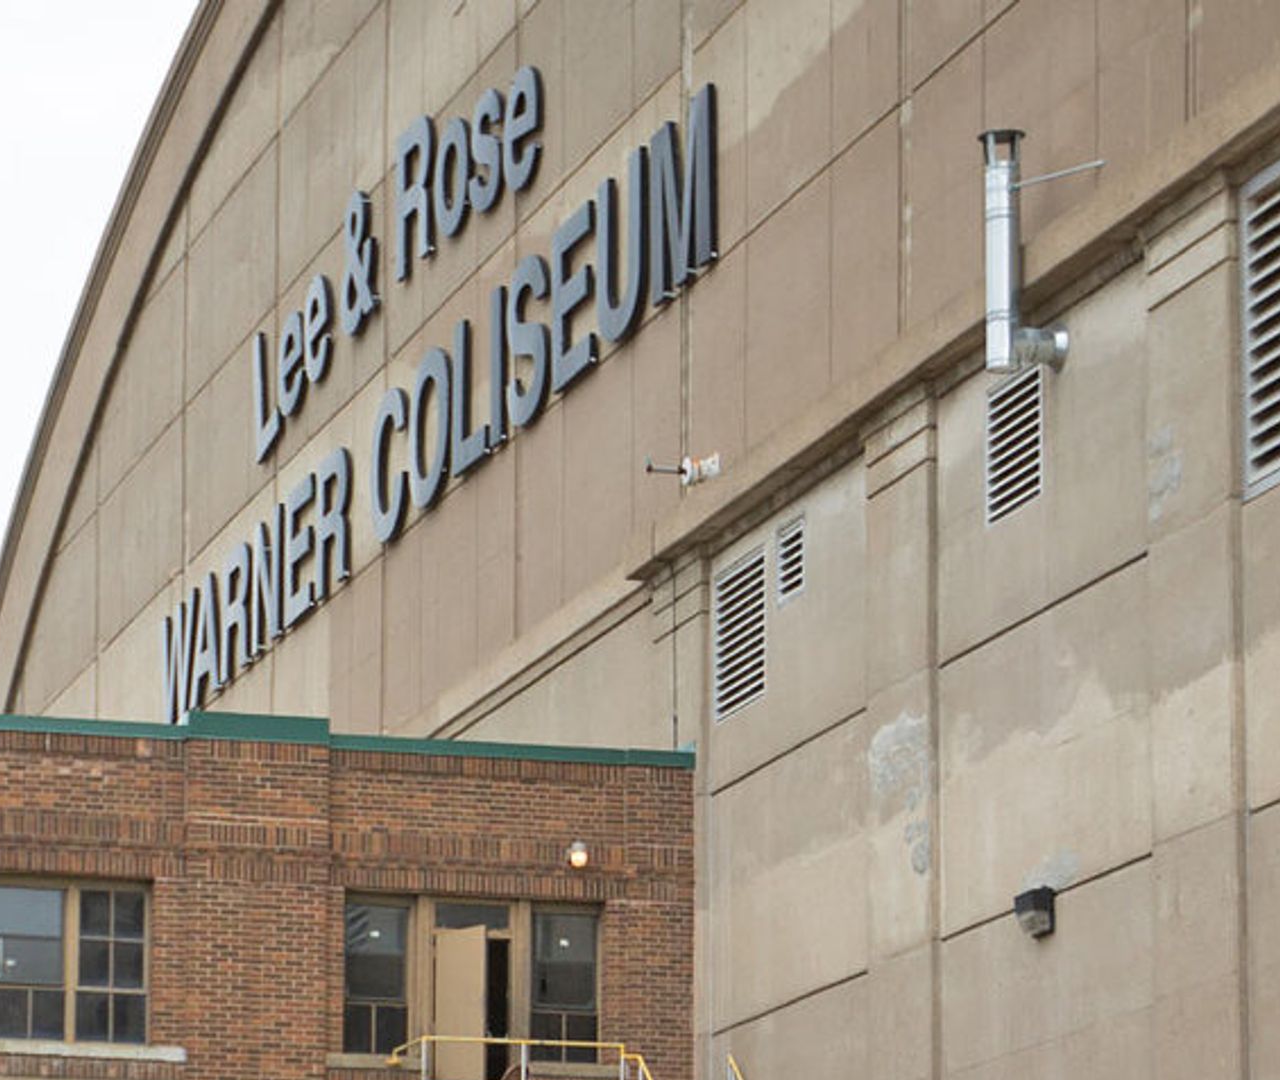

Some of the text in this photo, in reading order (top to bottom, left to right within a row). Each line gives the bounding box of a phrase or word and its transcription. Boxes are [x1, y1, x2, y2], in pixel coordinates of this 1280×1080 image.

[162, 82, 721, 726] WARNER COLISEUM
[252, 64, 545, 465] Lee & Rose
